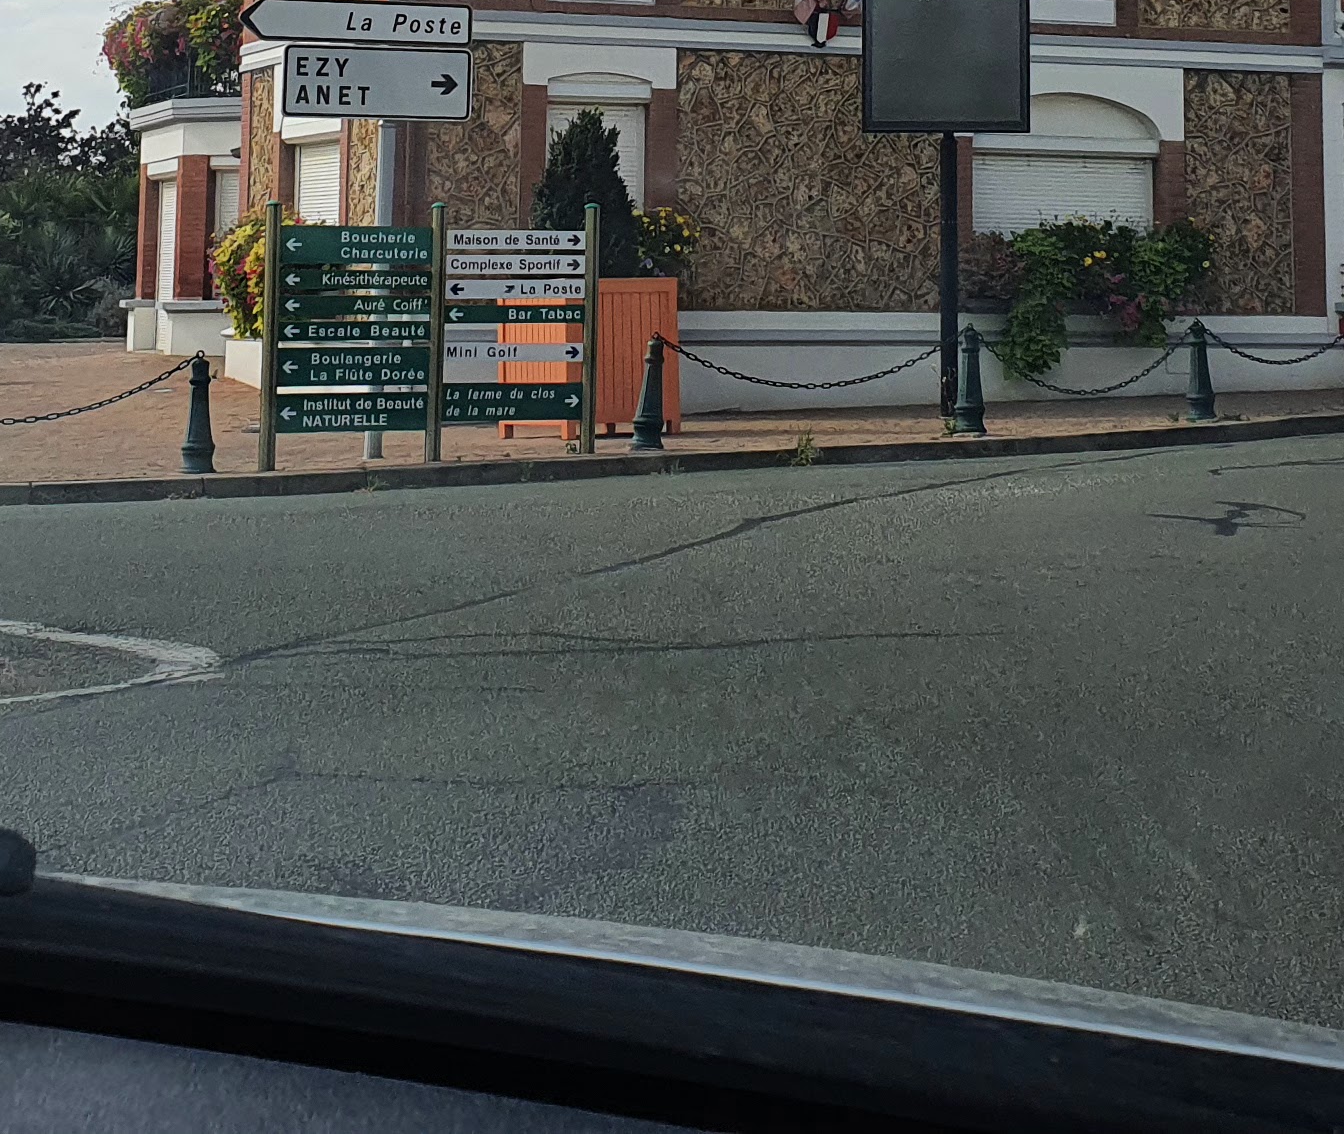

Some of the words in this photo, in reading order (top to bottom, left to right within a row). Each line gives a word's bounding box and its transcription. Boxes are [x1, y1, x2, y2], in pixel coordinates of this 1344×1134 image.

[346, 12, 372, 32] La
[392, 13, 462, 35] Poste
[296, 56, 350, 78] EZY
[295, 85, 371, 106] ANET
[341, 231, 416, 244] Boucherie
[453, 234, 498, 245] Maison
[504, 234, 519, 245] de
[525, 234, 560, 245] Santé
[340, 247, 428, 259] Charcuterie
[450, 258, 513, 272] Complexe
[519, 258, 561, 272] Sportif
[322, 273, 428, 288] Kinésithérapeute
[520, 283, 536, 294] La
[543, 283, 582, 295] Poste
[354, 299, 386, 312] Auré
[393, 299, 428, 311] Coiff'
[508, 308, 532, 319] Bar
[540, 308, 581, 319] Tabac
[308, 325, 360, 337] Escale
[370, 324, 425, 337] Beauté
[446, 346, 477, 357] Mini
[487, 346, 518, 357] Golf
[311, 352, 402, 366] Boulangerie
[310, 369, 328, 381] La
[336, 368, 373, 381] Flûte
[381, 367, 425, 380] Dorée
[446, 388, 460, 400] La
[467, 388, 502, 400] ferme
[510, 387, 524, 399] du
[531, 386, 555, 399] clos
[303, 399, 351, 411] Institut
[356, 398, 372, 409] de
[377, 397, 424, 409] Beauté
[446, 405, 460, 416] de
[467, 405, 478, 416] la
[485, 406, 516, 416] mare
[302, 414, 388, 427] NATUR'ELLE
